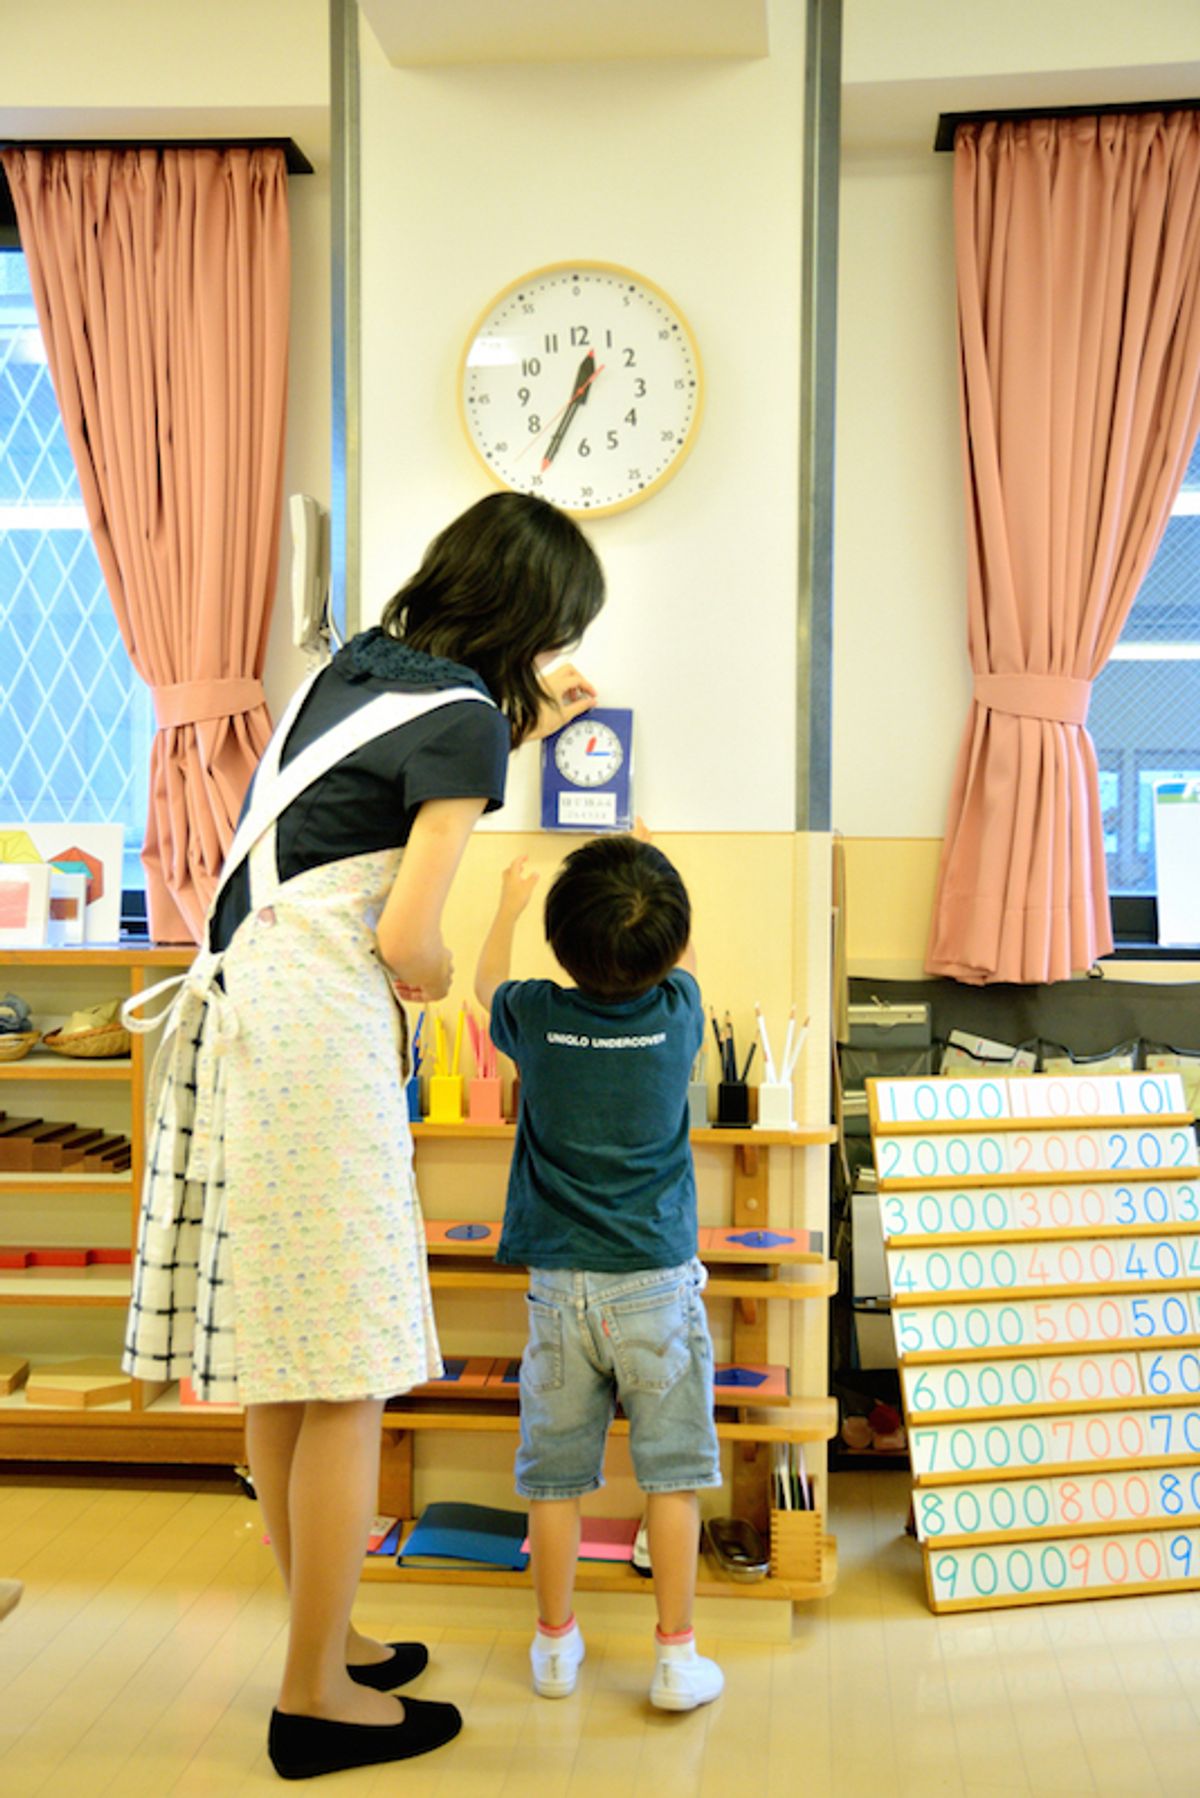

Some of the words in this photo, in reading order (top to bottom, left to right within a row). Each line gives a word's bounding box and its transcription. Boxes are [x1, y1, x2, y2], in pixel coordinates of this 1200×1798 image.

[521, 303, 535, 314] 55
[622, 296, 630, 307] 5
[545, 333, 559, 353] 11
[570, 326, 590, 346] 12
[605, 329, 612, 348] 1
[658, 330, 670, 341] 10
[622, 348, 636, 368] 2
[521, 358, 541, 377] 10
[634, 378, 647, 398] 3
[674, 379, 685, 389] 15
[478, 395, 490, 405] 45
[517, 387, 531, 407] 9
[528, 415, 541, 433] 8
[624, 408, 637, 426] 4
[606, 430, 619, 450] 5
[661, 431, 674, 442] 20
[495, 442, 508, 453] 40
[578, 438, 591, 457] 6
[531, 475, 543, 486] 35
[628, 469, 642, 480] 25
[580, 487, 594, 497] 30
[546, 1031, 590, 1048] UNIQLO
[591, 1032, 666, 1049] UNDERCOVER
